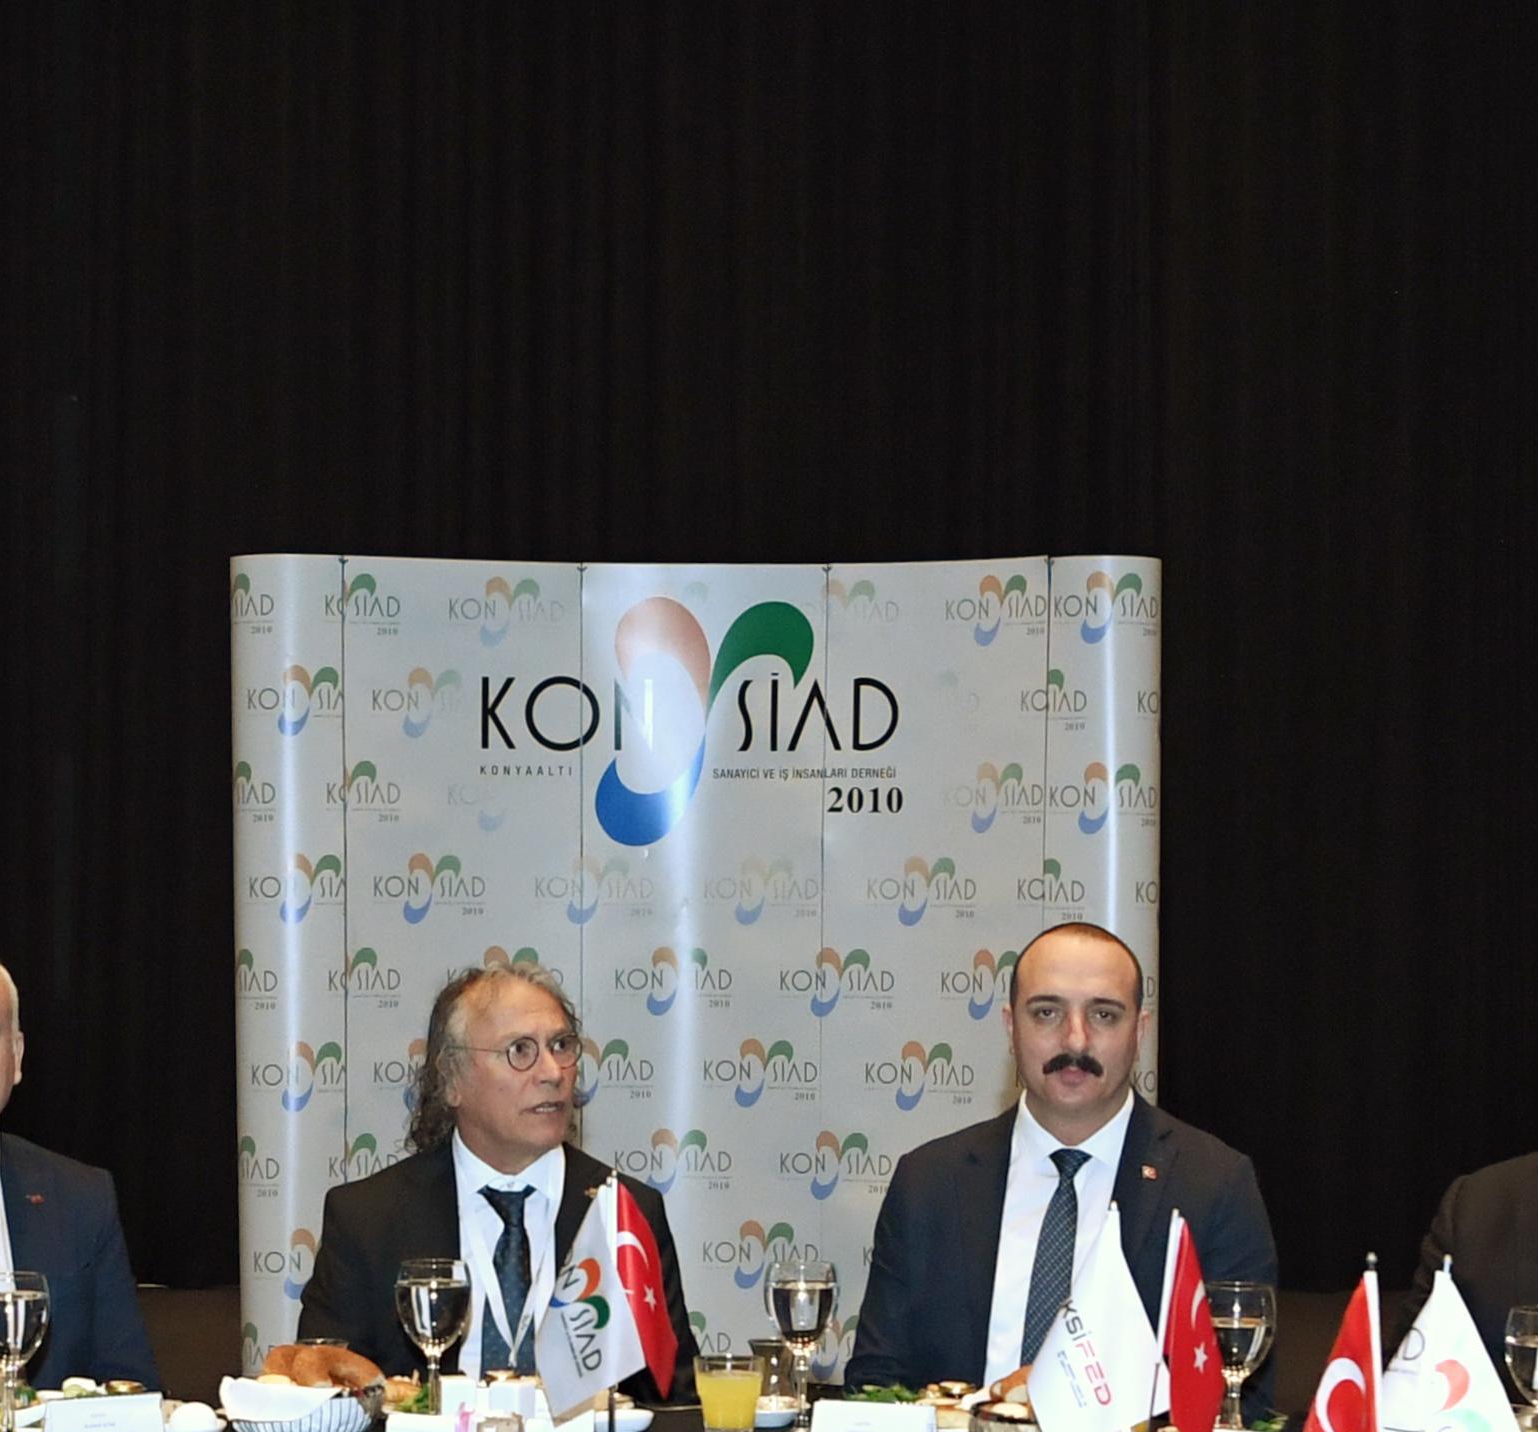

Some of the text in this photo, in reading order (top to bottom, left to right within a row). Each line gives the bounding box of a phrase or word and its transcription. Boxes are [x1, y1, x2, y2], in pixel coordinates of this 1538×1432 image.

[946, 599, 989, 621] KON
[1054, 595, 1097, 617] KON
[372, 689, 419, 711] KON
[480, 765, 573, 776] KONYAALTI
[763, 768, 776, 780] VE
[826, 786, 904, 814] 2010
[1049, 785, 1095, 808] KON
[373, 876, 419, 898] KON
[867, 878, 915, 899] KON
[615, 968, 663, 990] KON
[780, 970, 826, 992] KON
[941, 971, 983, 993] KON
[703, 1060, 751, 1082] KON
[865, 1062, 912, 1084] KON
[614, 1150, 663, 1172] KON
[779, 1152, 826, 1174] KON
[254, 1251, 301, 1273] KON
[702, 1241, 751, 1263] KON
